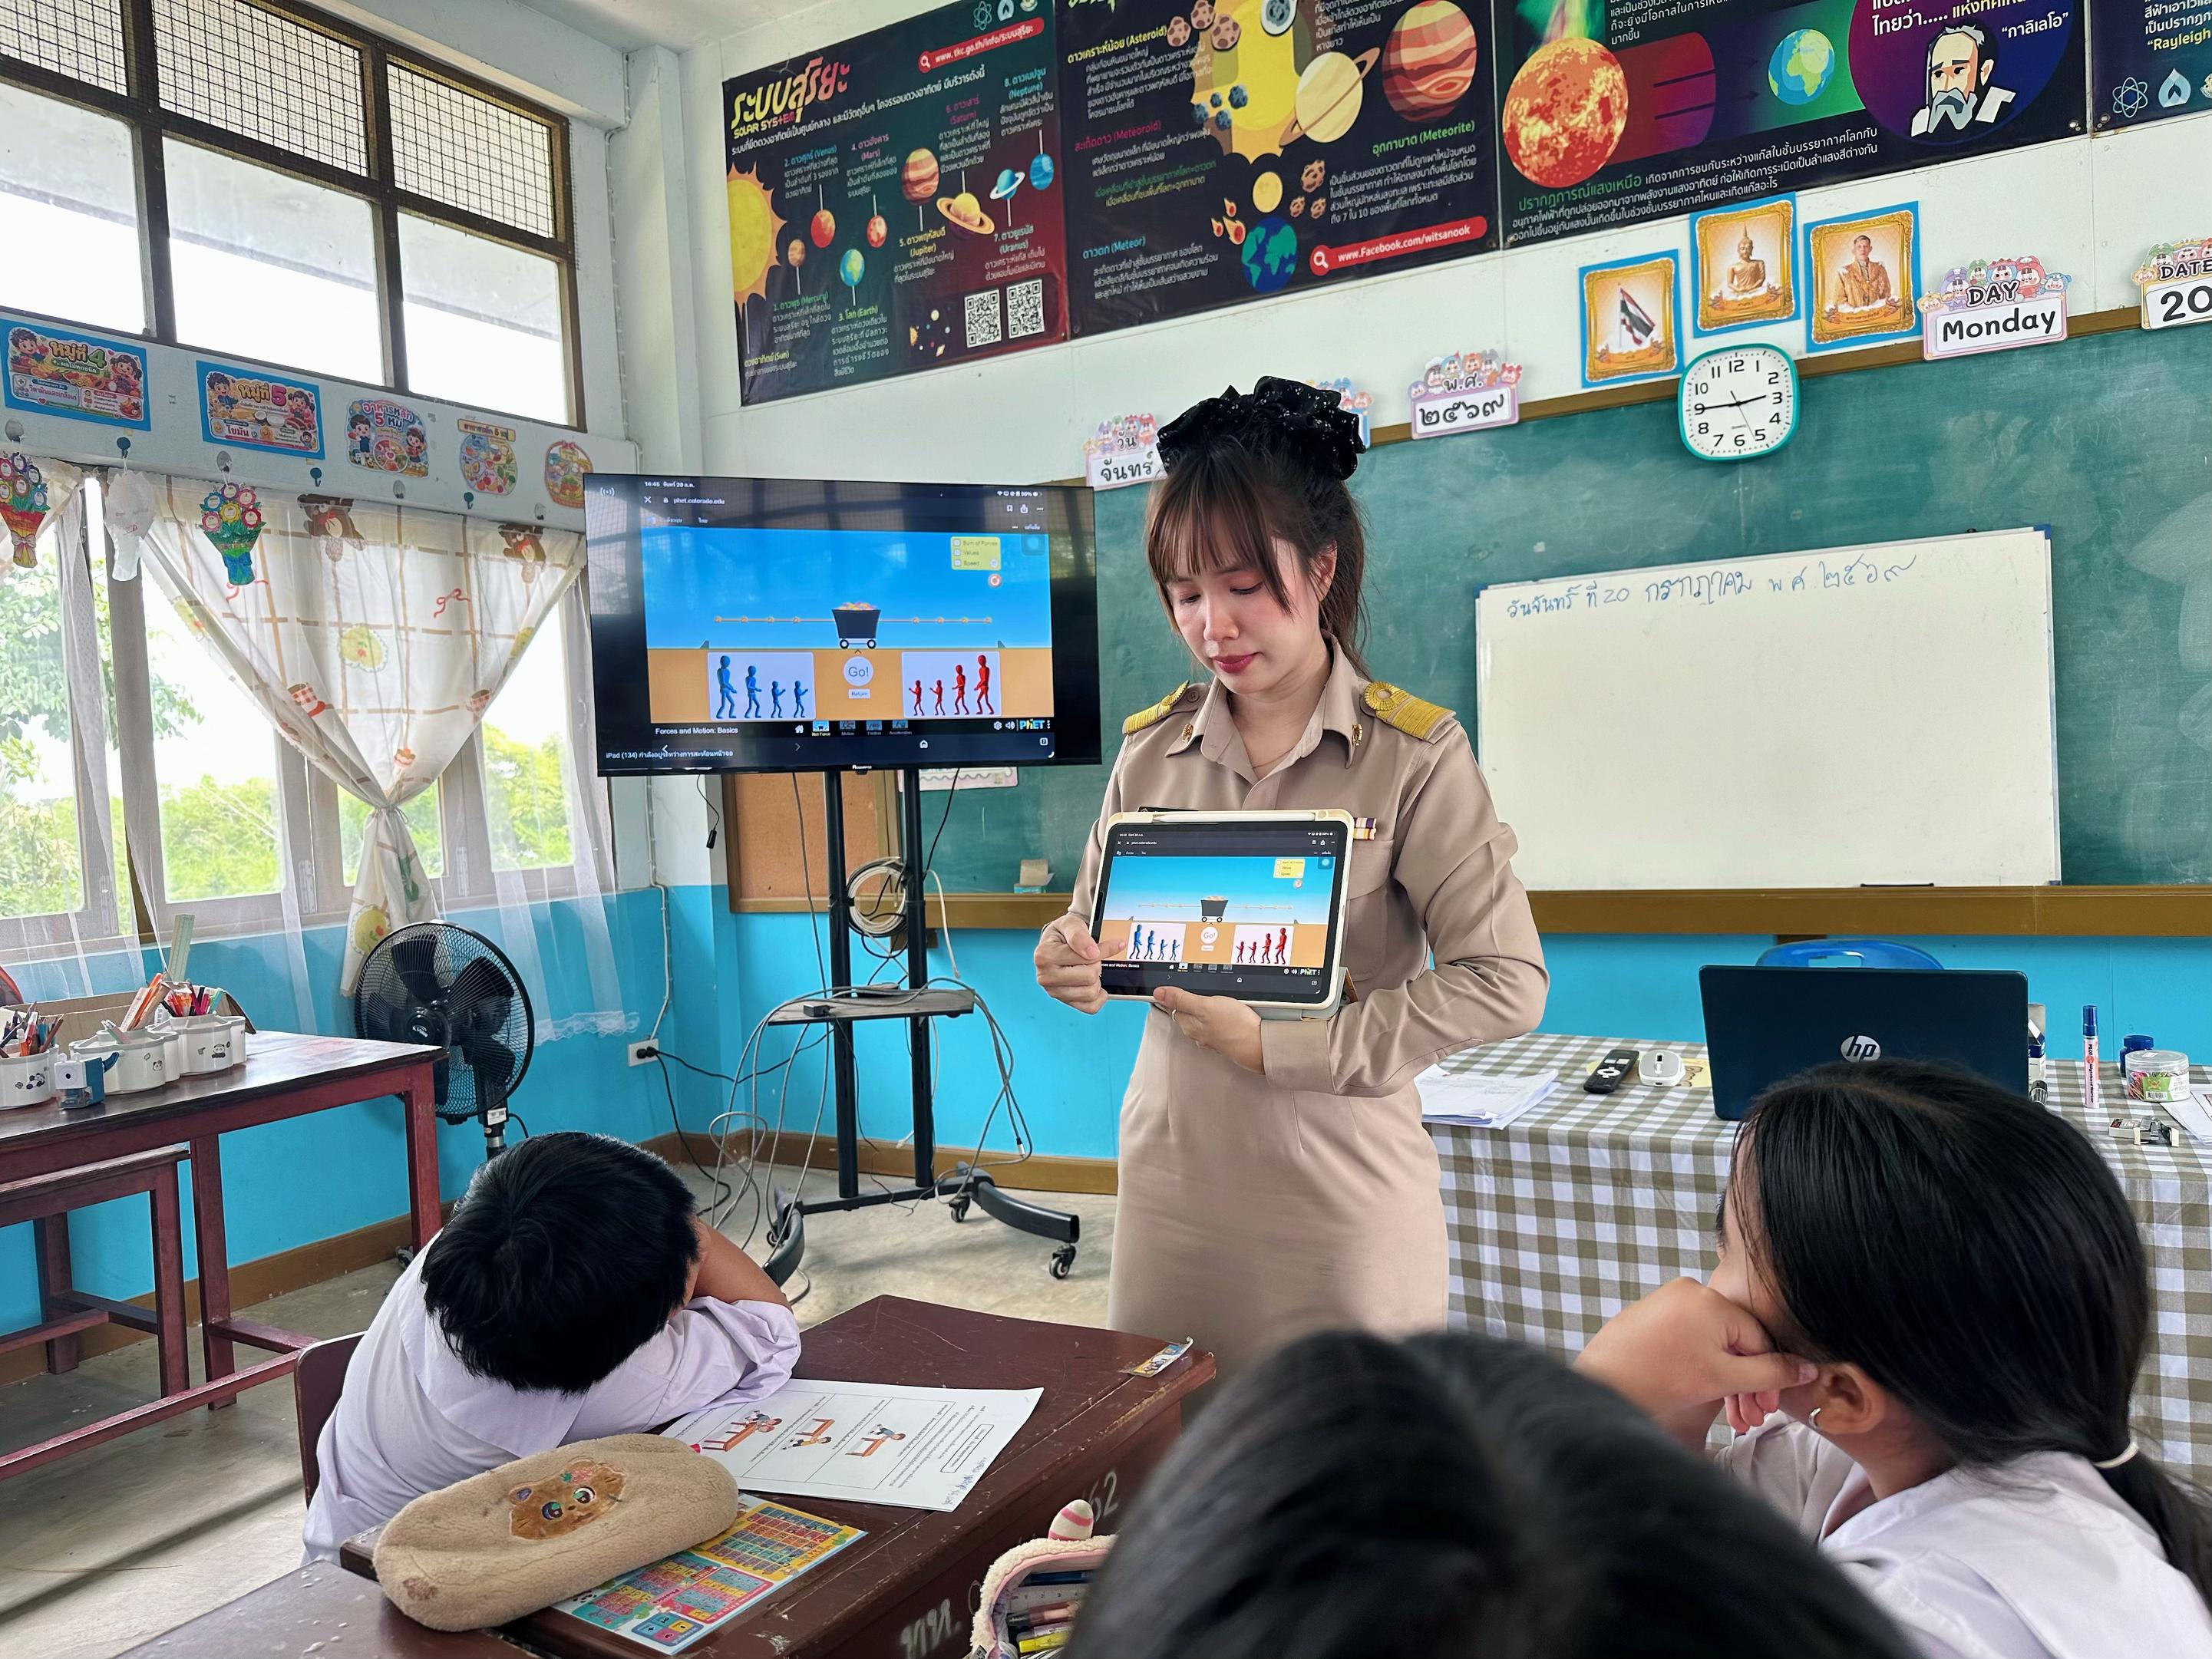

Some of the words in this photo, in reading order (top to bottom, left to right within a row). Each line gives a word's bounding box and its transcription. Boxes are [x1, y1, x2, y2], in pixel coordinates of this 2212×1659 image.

[2002, 12, 2068, 38] “กาลิเลโอ”
[1068, 38, 1125, 64] ดาวเคราะห์น้อย
[1126, 26, 1167, 48] (Asteroid)
[731, 56, 850, 129] ระบบสุริยะ
[734, 123, 759, 140] SOLAR
[1113, 120, 1161, 141] (Meteoroid)
[1419, 120, 1475, 144] (Meteorite)
[1359, 207, 1368, 218] 10
[1111, 236, 1146, 253] (Meteor)
[1338, 224, 1471, 262] www.Facebook.com/witsanook
[2159, 264, 2212, 280] DATE
[1968, 281, 2019, 306] DAY
[1943, 307, 2057, 343] Monday
[49, 341, 88, 363] หมู่ที่
[88, 348, 107, 369] 4
[1712, 365, 1721, 379] 11
[1728, 359, 1745, 373] 12
[1444, 373, 1483, 391] พ.ศ.
[1768, 371, 1779, 384] 2
[239, 382, 271, 404] หมู่ที่
[271, 385, 287, 407] 5
[1695, 382, 1709, 395] 10
[1772, 391, 1783, 404] 3
[362, 402, 413, 422] อาหารหลัก
[1419, 394, 1504, 426] ๒๕๖๙
[1694, 403, 1705, 415] 9
[375, 412, 385, 427] 5
[1769, 412, 1781, 424] 4
[226, 424, 249, 437] ไขมัน
[1698, 422, 1709, 434] 8
[1755, 428, 1766, 442] 5
[1117, 430, 1137, 450] วัน
[1712, 434, 1724, 447] 7
[1734, 434, 1745, 447] 6
[1101, 450, 1154, 482] จันทร์
[1603, 588, 1629, 603] 20
[1768, 577, 1783, 592] พ
[1791, 566, 1809, 591] ศ
[1820, 552, 1917, 589] ๒๕๖๙
[848, 666, 869, 678] Go!
[621, 751, 638, 760] (134)
[1844, 1035, 1877, 1062] hp
